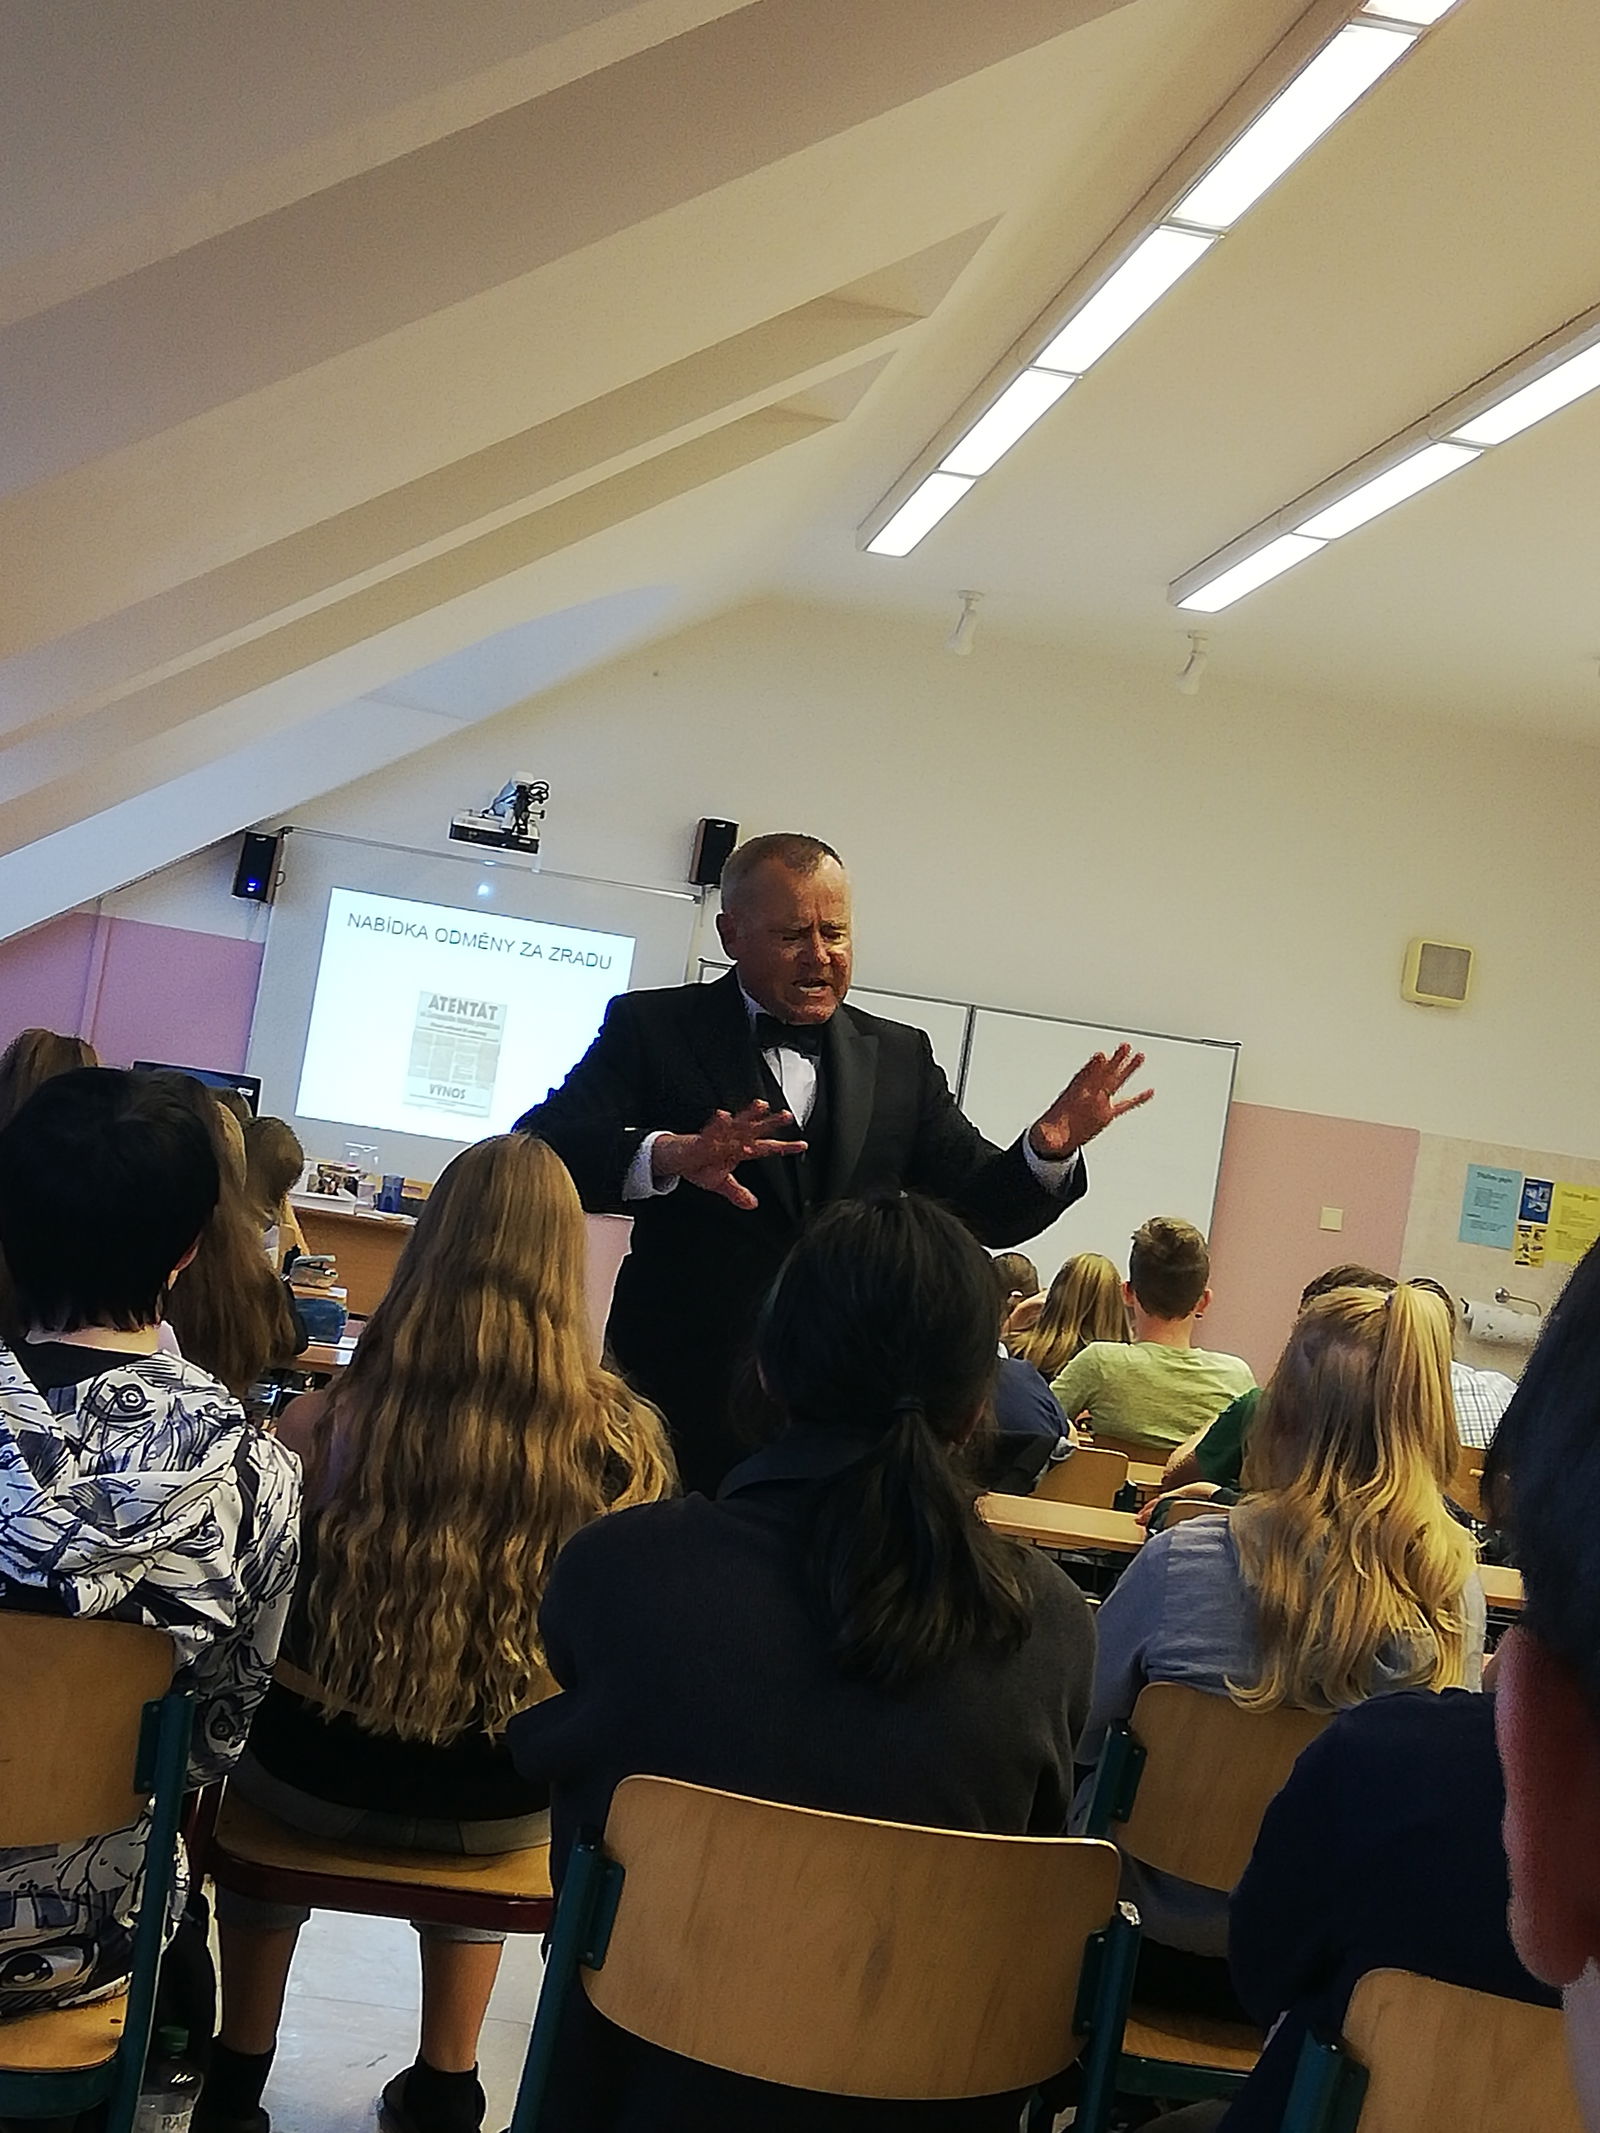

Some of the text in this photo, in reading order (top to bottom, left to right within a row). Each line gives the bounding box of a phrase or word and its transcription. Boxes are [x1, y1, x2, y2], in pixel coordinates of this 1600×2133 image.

[347, 912, 613, 970] NABÍDKA ODMĚNY ZA ZRADU
